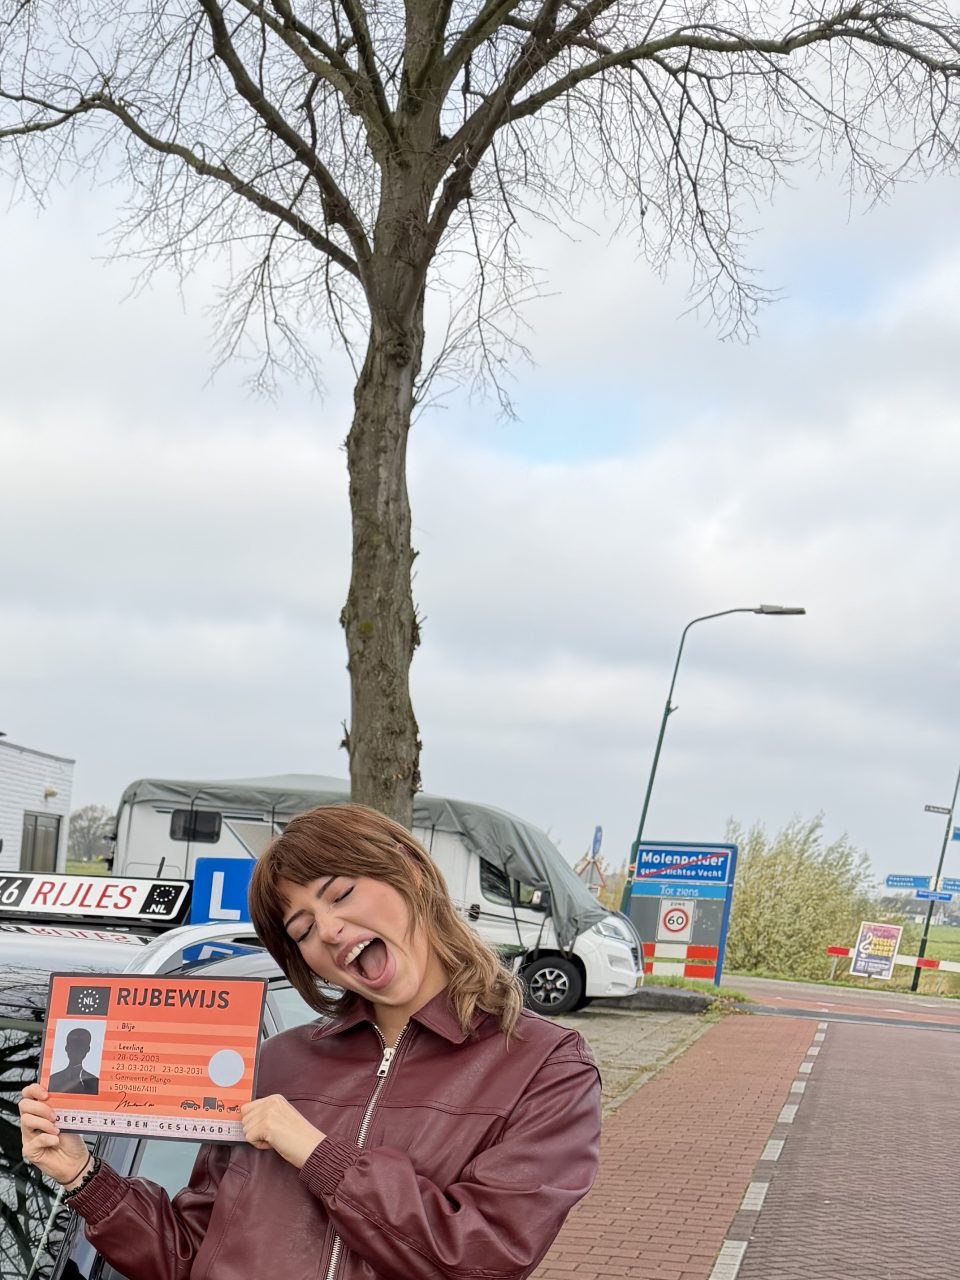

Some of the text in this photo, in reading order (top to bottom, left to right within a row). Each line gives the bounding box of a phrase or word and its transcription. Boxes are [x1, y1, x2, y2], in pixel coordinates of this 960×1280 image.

[641, 852, 725, 866] Molenpolder
[698, 869, 722, 878] Vecht
[31, 880, 138, 910] RIJLES
[208, 871, 241, 920] L
[676, 887, 700, 897] ziens
[146, 903, 167, 914] .NL
[667, 915, 684, 926] 60
[83, 996, 95, 1006] NL
[116, 987, 230, 1009] RIJBEWIJS
[118, 1043, 144, 1053] Leerling
[162, 1066, 203, 1075] 23-03-2031
[115, 1073, 148, 1083] Gemeente
[103, 1118, 116, 1126] IK
[127, 1120, 148, 1128] BEN
[159, 1122, 232, 1134] GESLAAGD!
